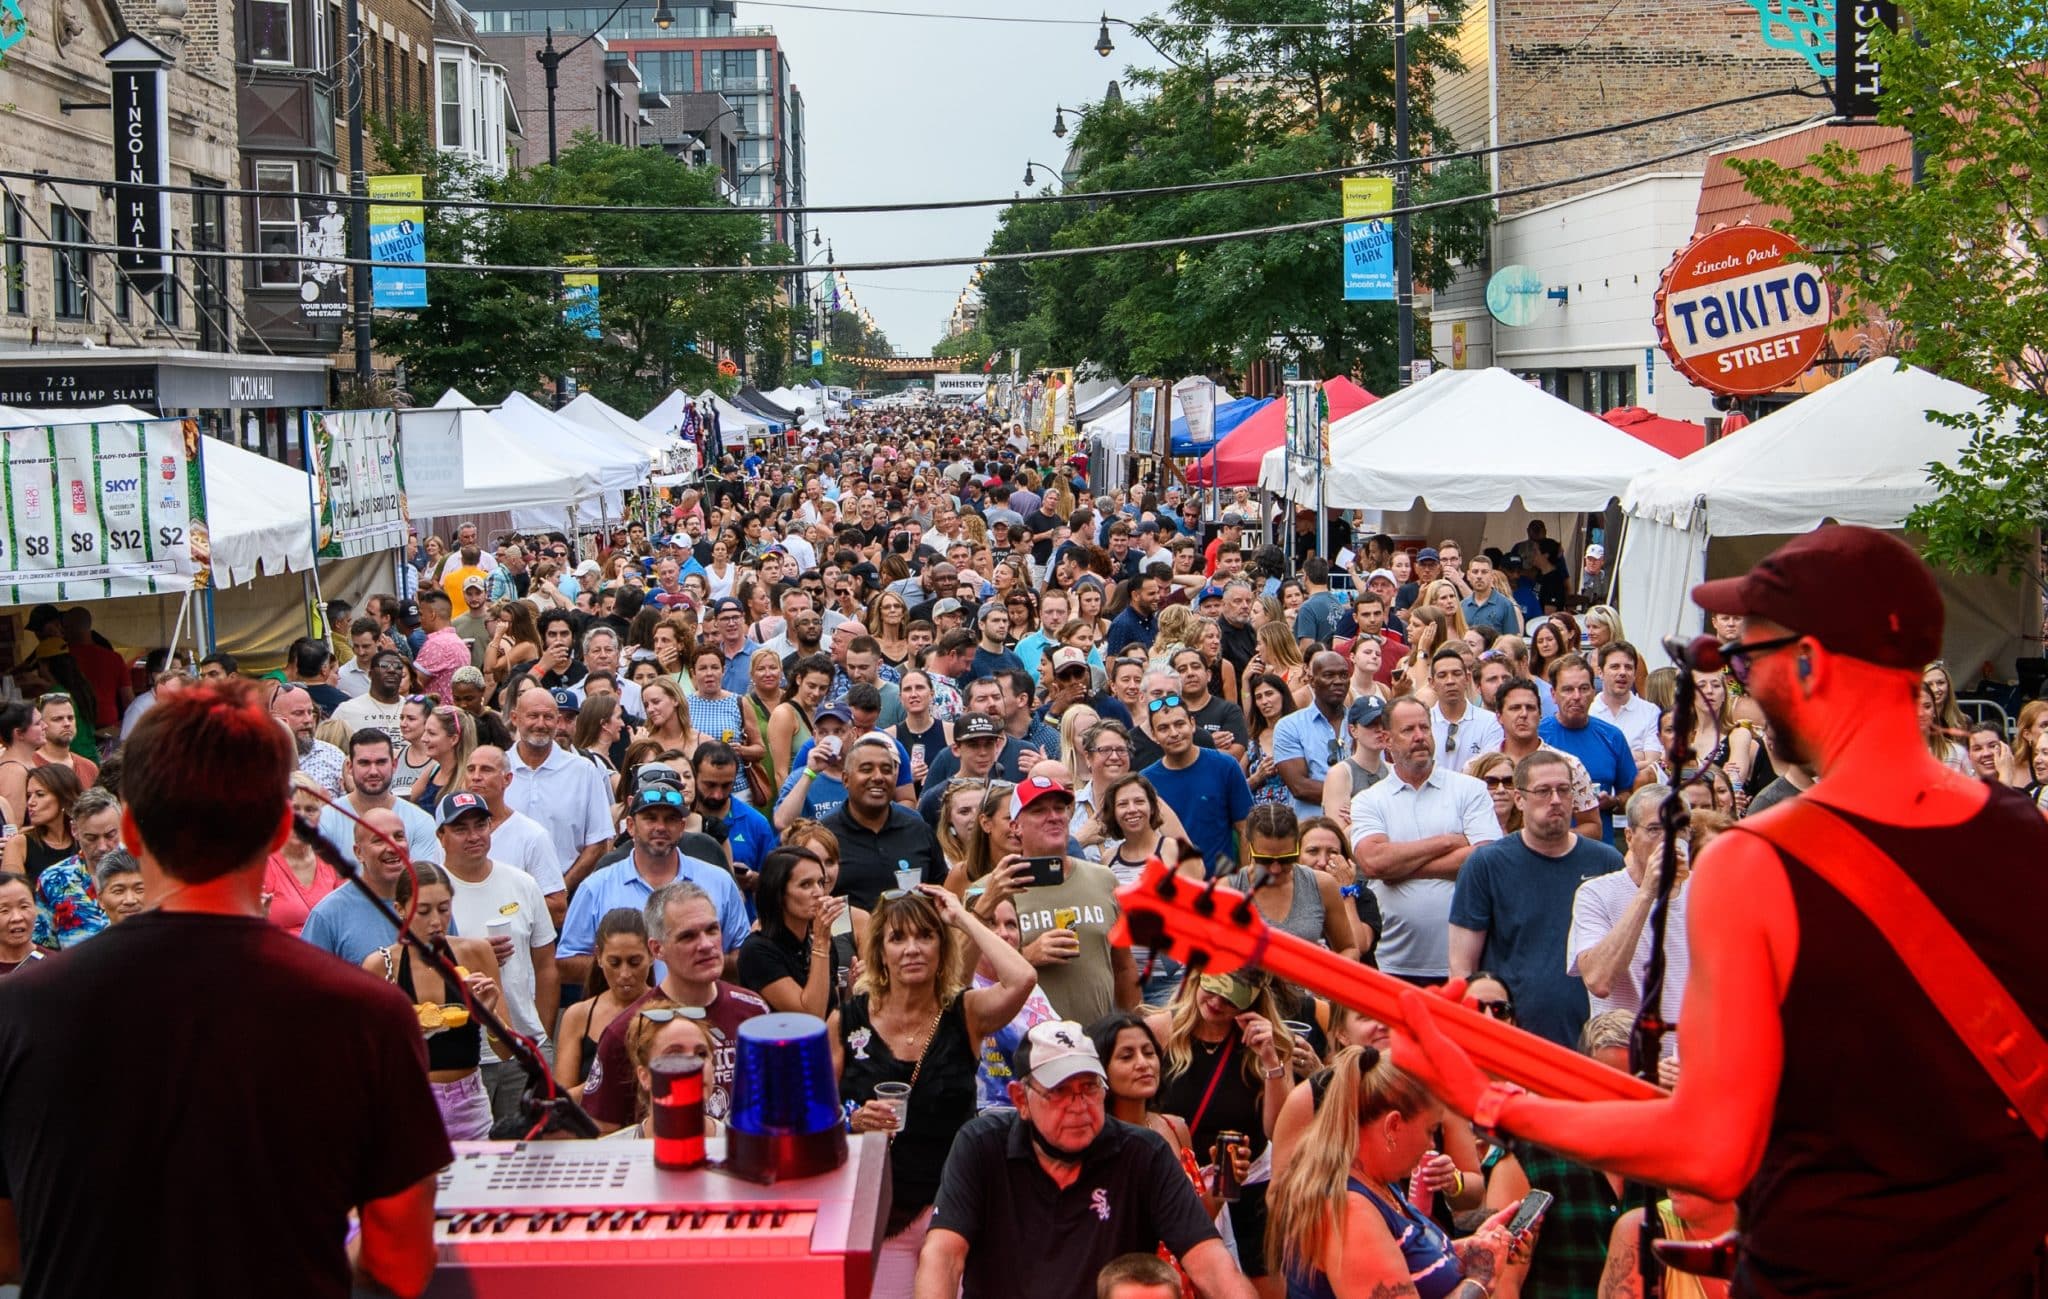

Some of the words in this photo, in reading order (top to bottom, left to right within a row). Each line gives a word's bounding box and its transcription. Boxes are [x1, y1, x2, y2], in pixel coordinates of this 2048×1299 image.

[129, 76, 144, 184] LINCOLN
[131, 202, 145, 264] HALL
[370, 226, 400, 246] MAKE
[400, 220, 413, 235] it
[378, 232, 425, 257] LINCOLN
[1344, 226, 1369, 245] MAKE
[1351, 231, 1392, 254] LINCOLN
[1354, 247, 1383, 266] PARK
[1692, 255, 1741, 276] Lincoln
[1746, 244, 1781, 265] Park
[1718, 336, 1800, 373] STREET
[40, 391, 62, 401] THE
[71, 390, 106, 401] VAMP
[230, 376, 258, 400] LINCOLN
[259, 376, 274, 400] HALL
[939, 381, 985, 389] WHISKEY
[105, 478, 138, 493] SKYY
[160, 500, 181, 509] WATER
[25, 534, 50, 558] $8
[71, 531, 94, 555] $8
[110, 529, 143, 552] $12
[159, 526, 184, 549] $2
[814, 802, 831, 812] THE
[1020, 908, 1060, 932] GIR
